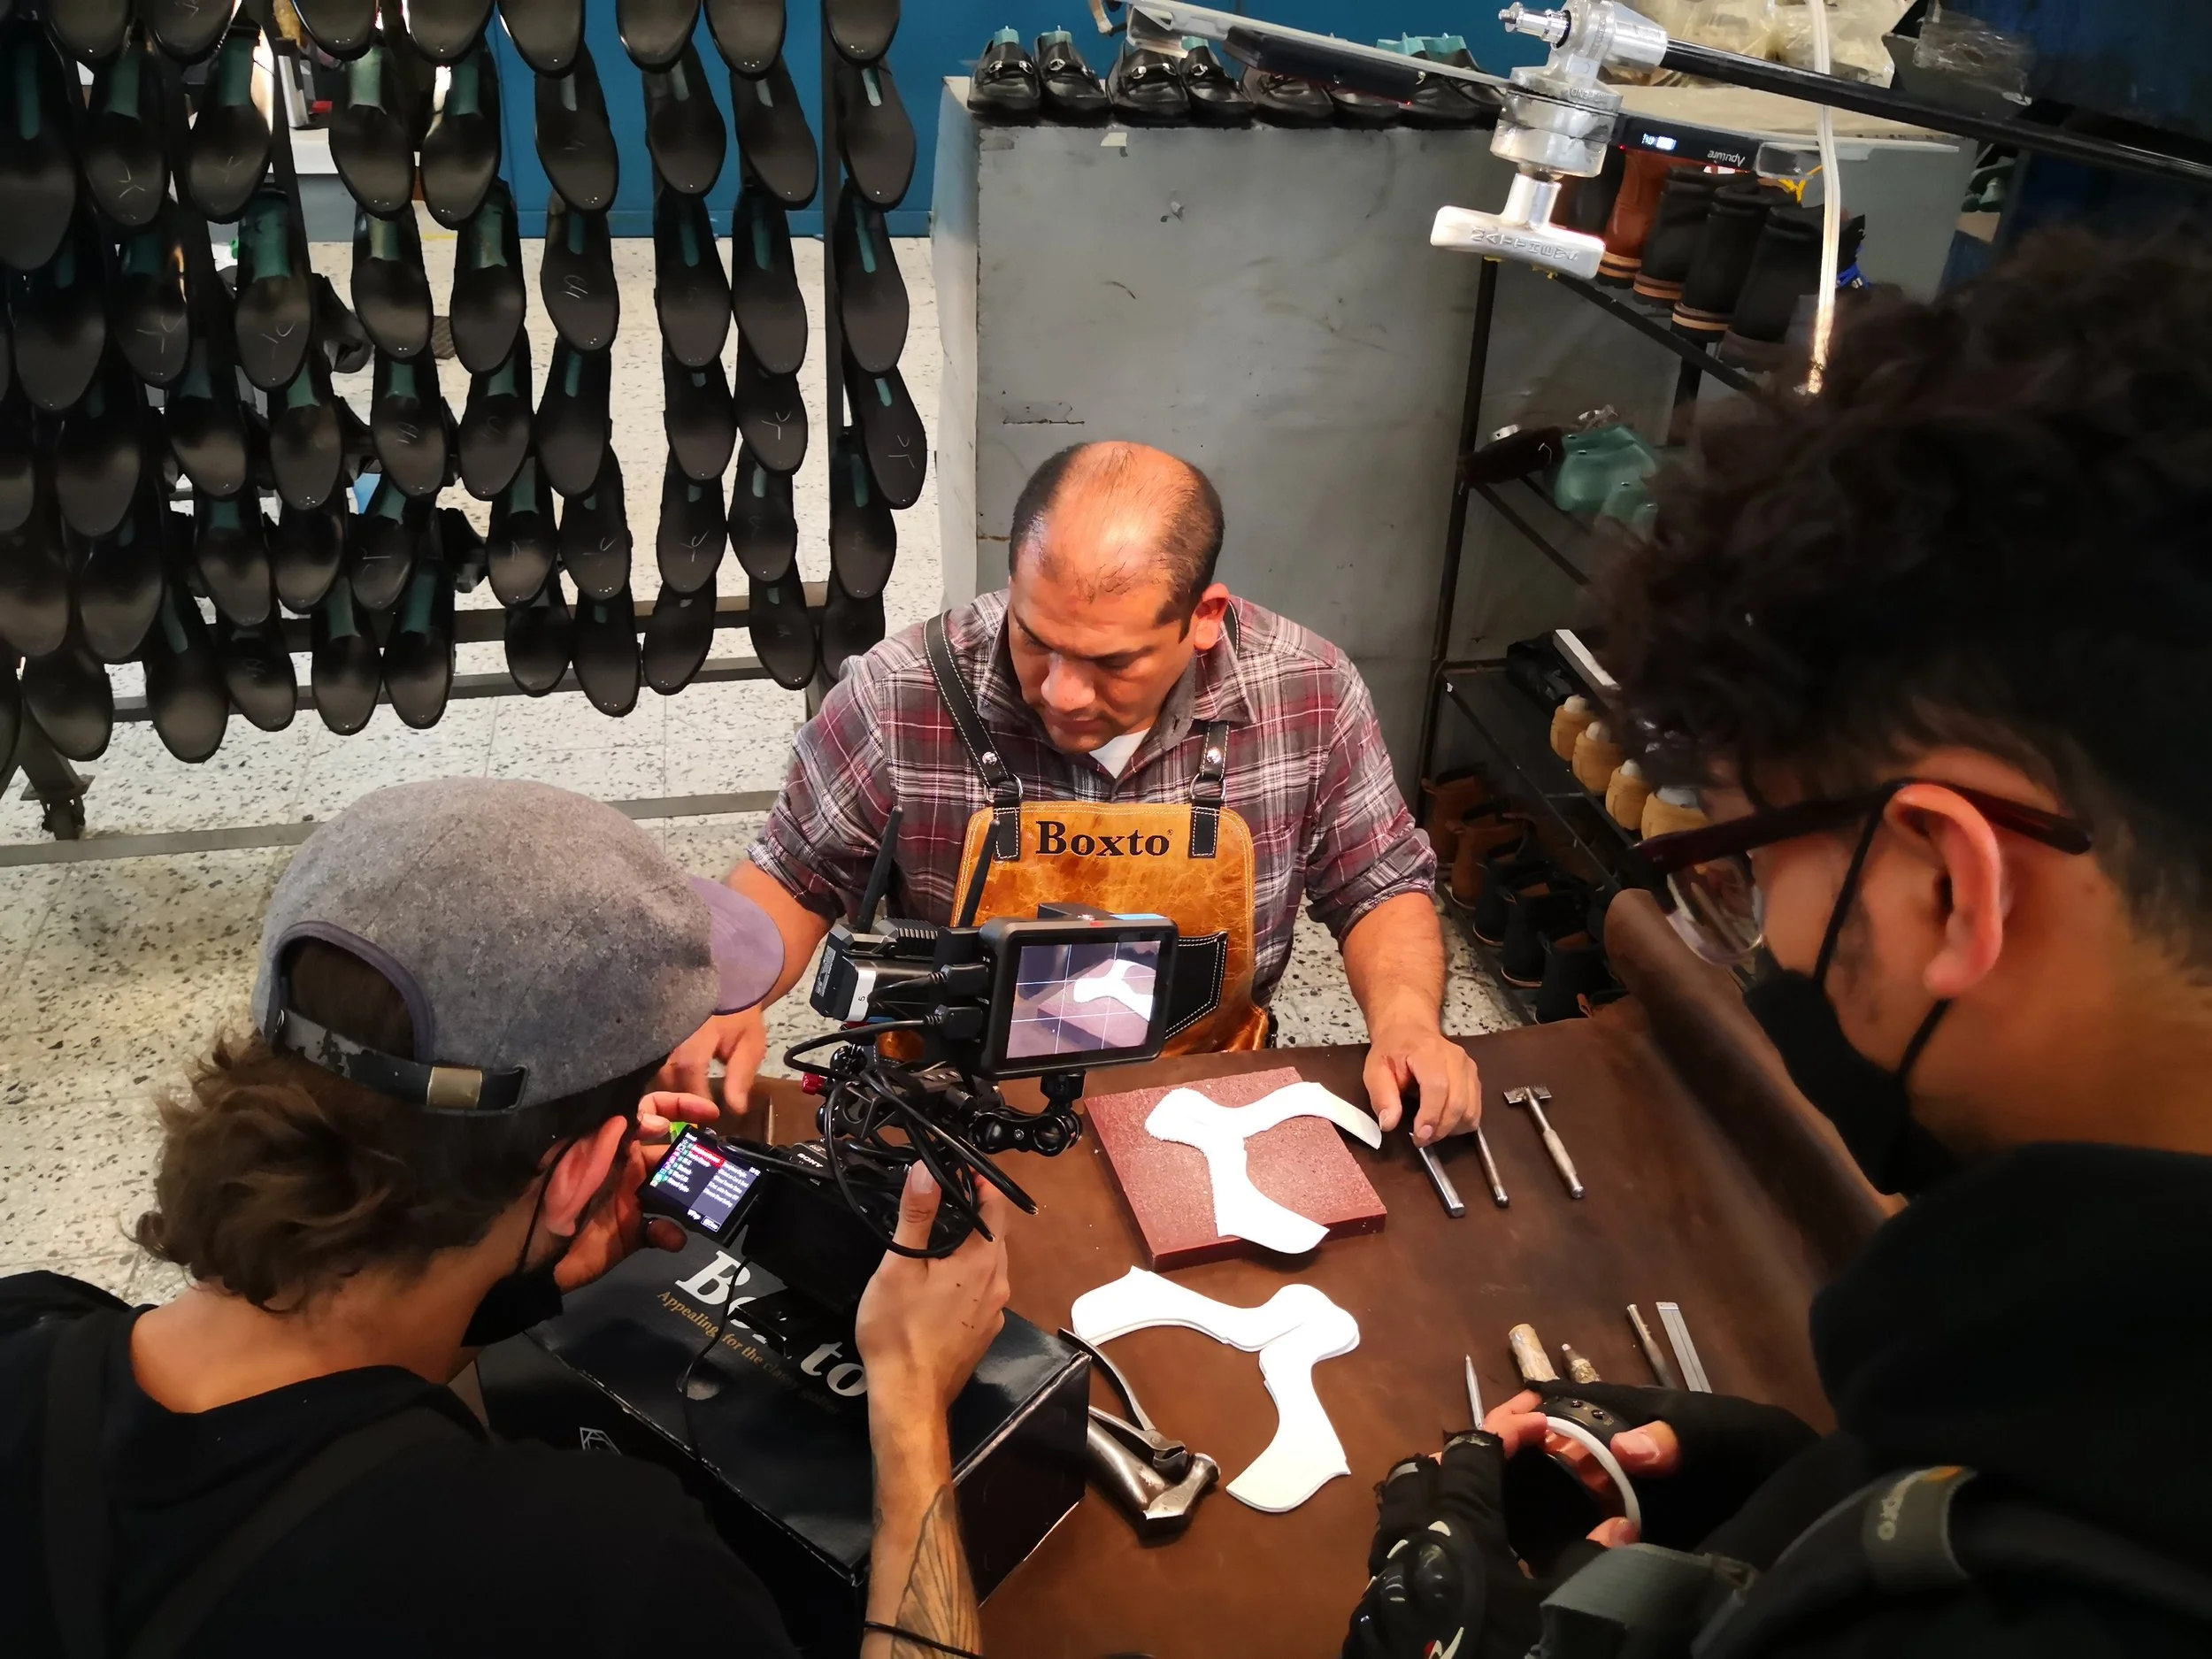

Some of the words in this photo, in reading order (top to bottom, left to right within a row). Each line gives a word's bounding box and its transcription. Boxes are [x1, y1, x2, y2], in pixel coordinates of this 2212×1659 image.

[1707, 150, 1746, 167] Aputure
[1036, 820, 1170, 856] Boxto
[797, 1152, 824, 1168] SONY
[657, 1291, 719, 1338] Appealing
[722, 1333, 744, 1351] for
[742, 1346, 764, 1364] the
[674, 1250, 868, 1397] Bto
